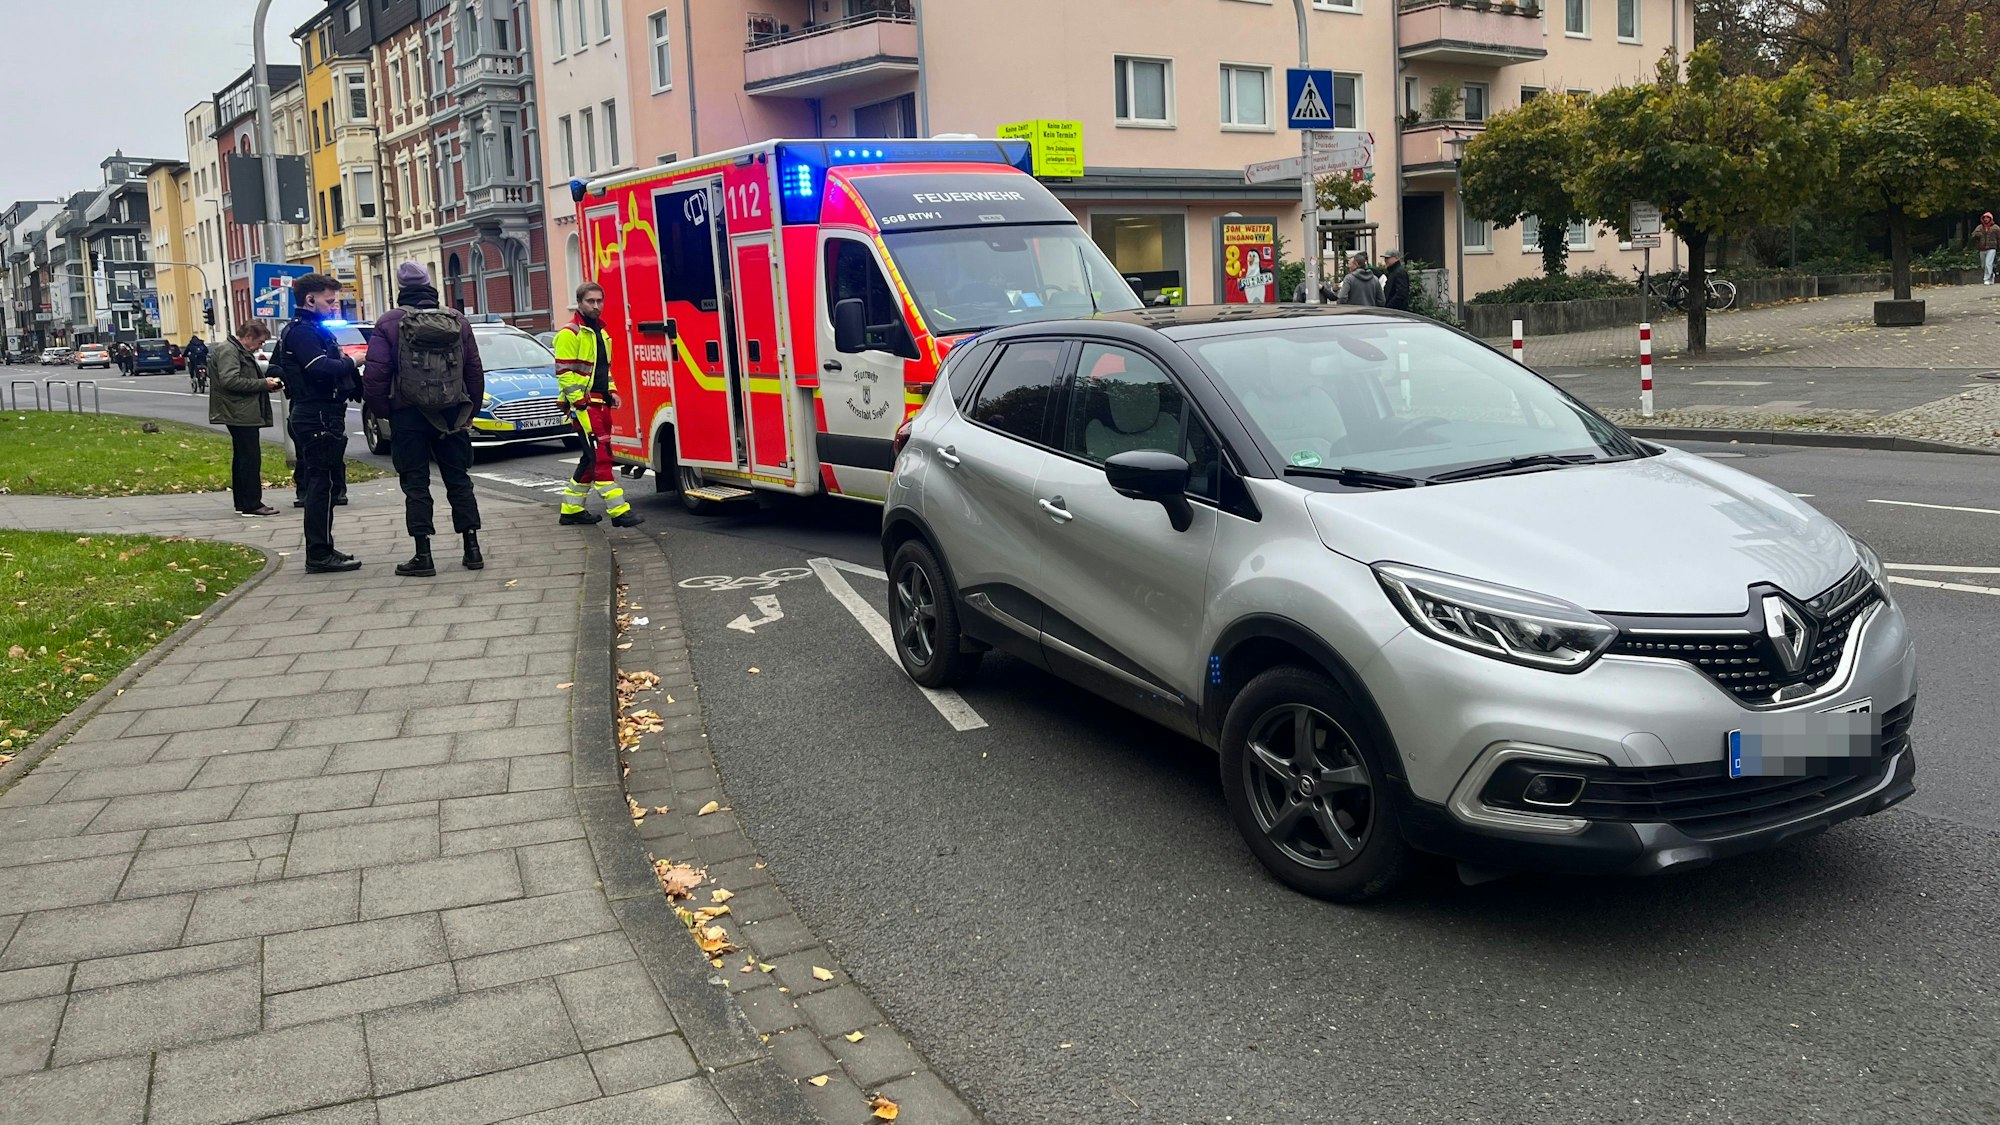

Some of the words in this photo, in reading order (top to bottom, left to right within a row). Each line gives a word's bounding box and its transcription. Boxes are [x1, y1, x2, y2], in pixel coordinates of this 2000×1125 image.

[1056, 131, 1077, 139] Termin?
[1315, 141, 1339, 149] Troisdorf
[728, 181, 762, 220] 112
[913, 191, 1026, 204] FEUERWEHR
[881, 213, 907, 225] SGB
[907, 211, 934, 221] RTW
[934, 211, 943, 219] 1
[1245, 225, 1271, 233] WEITER
[1226, 234, 1255, 242] EINGANG
[488, 373, 553, 384] POLIZEI
[853, 369, 879, 383] Feuerwehr
[521, 420, 534, 429] NRW
[544, 417, 560, 427] 7728
